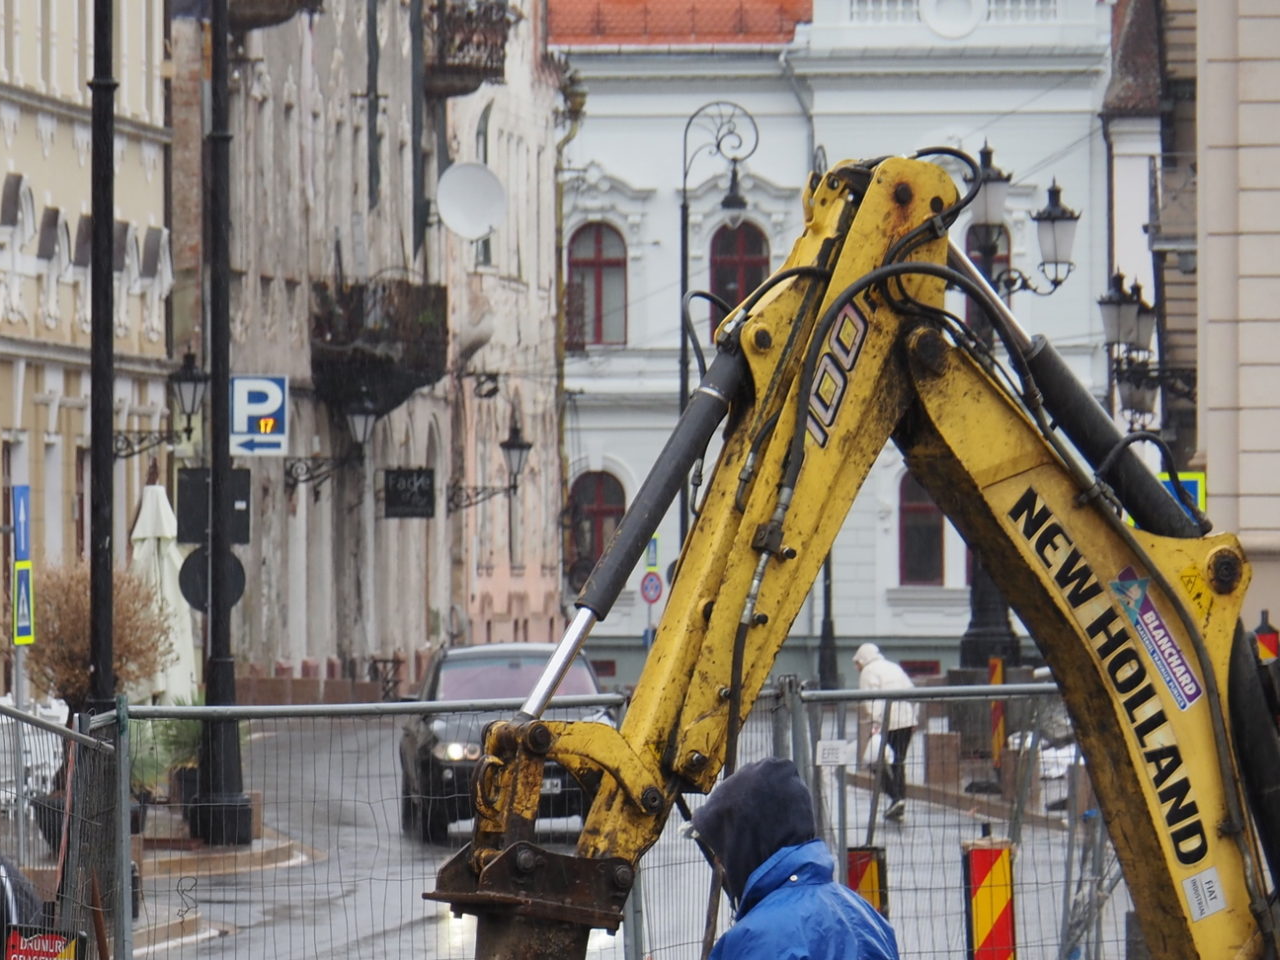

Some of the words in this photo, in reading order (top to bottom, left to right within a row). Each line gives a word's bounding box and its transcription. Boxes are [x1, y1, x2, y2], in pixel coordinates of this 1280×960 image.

[233, 379, 283, 434] P
[1007, 486, 1105, 609] NEW
[1085, 606, 1209, 866] HOLLAND
[1143, 611, 1196, 695] BLANCHARD
[1191, 878, 1205, 917] INDUSTRIAL
[1204, 880, 1217, 901] FIAT
